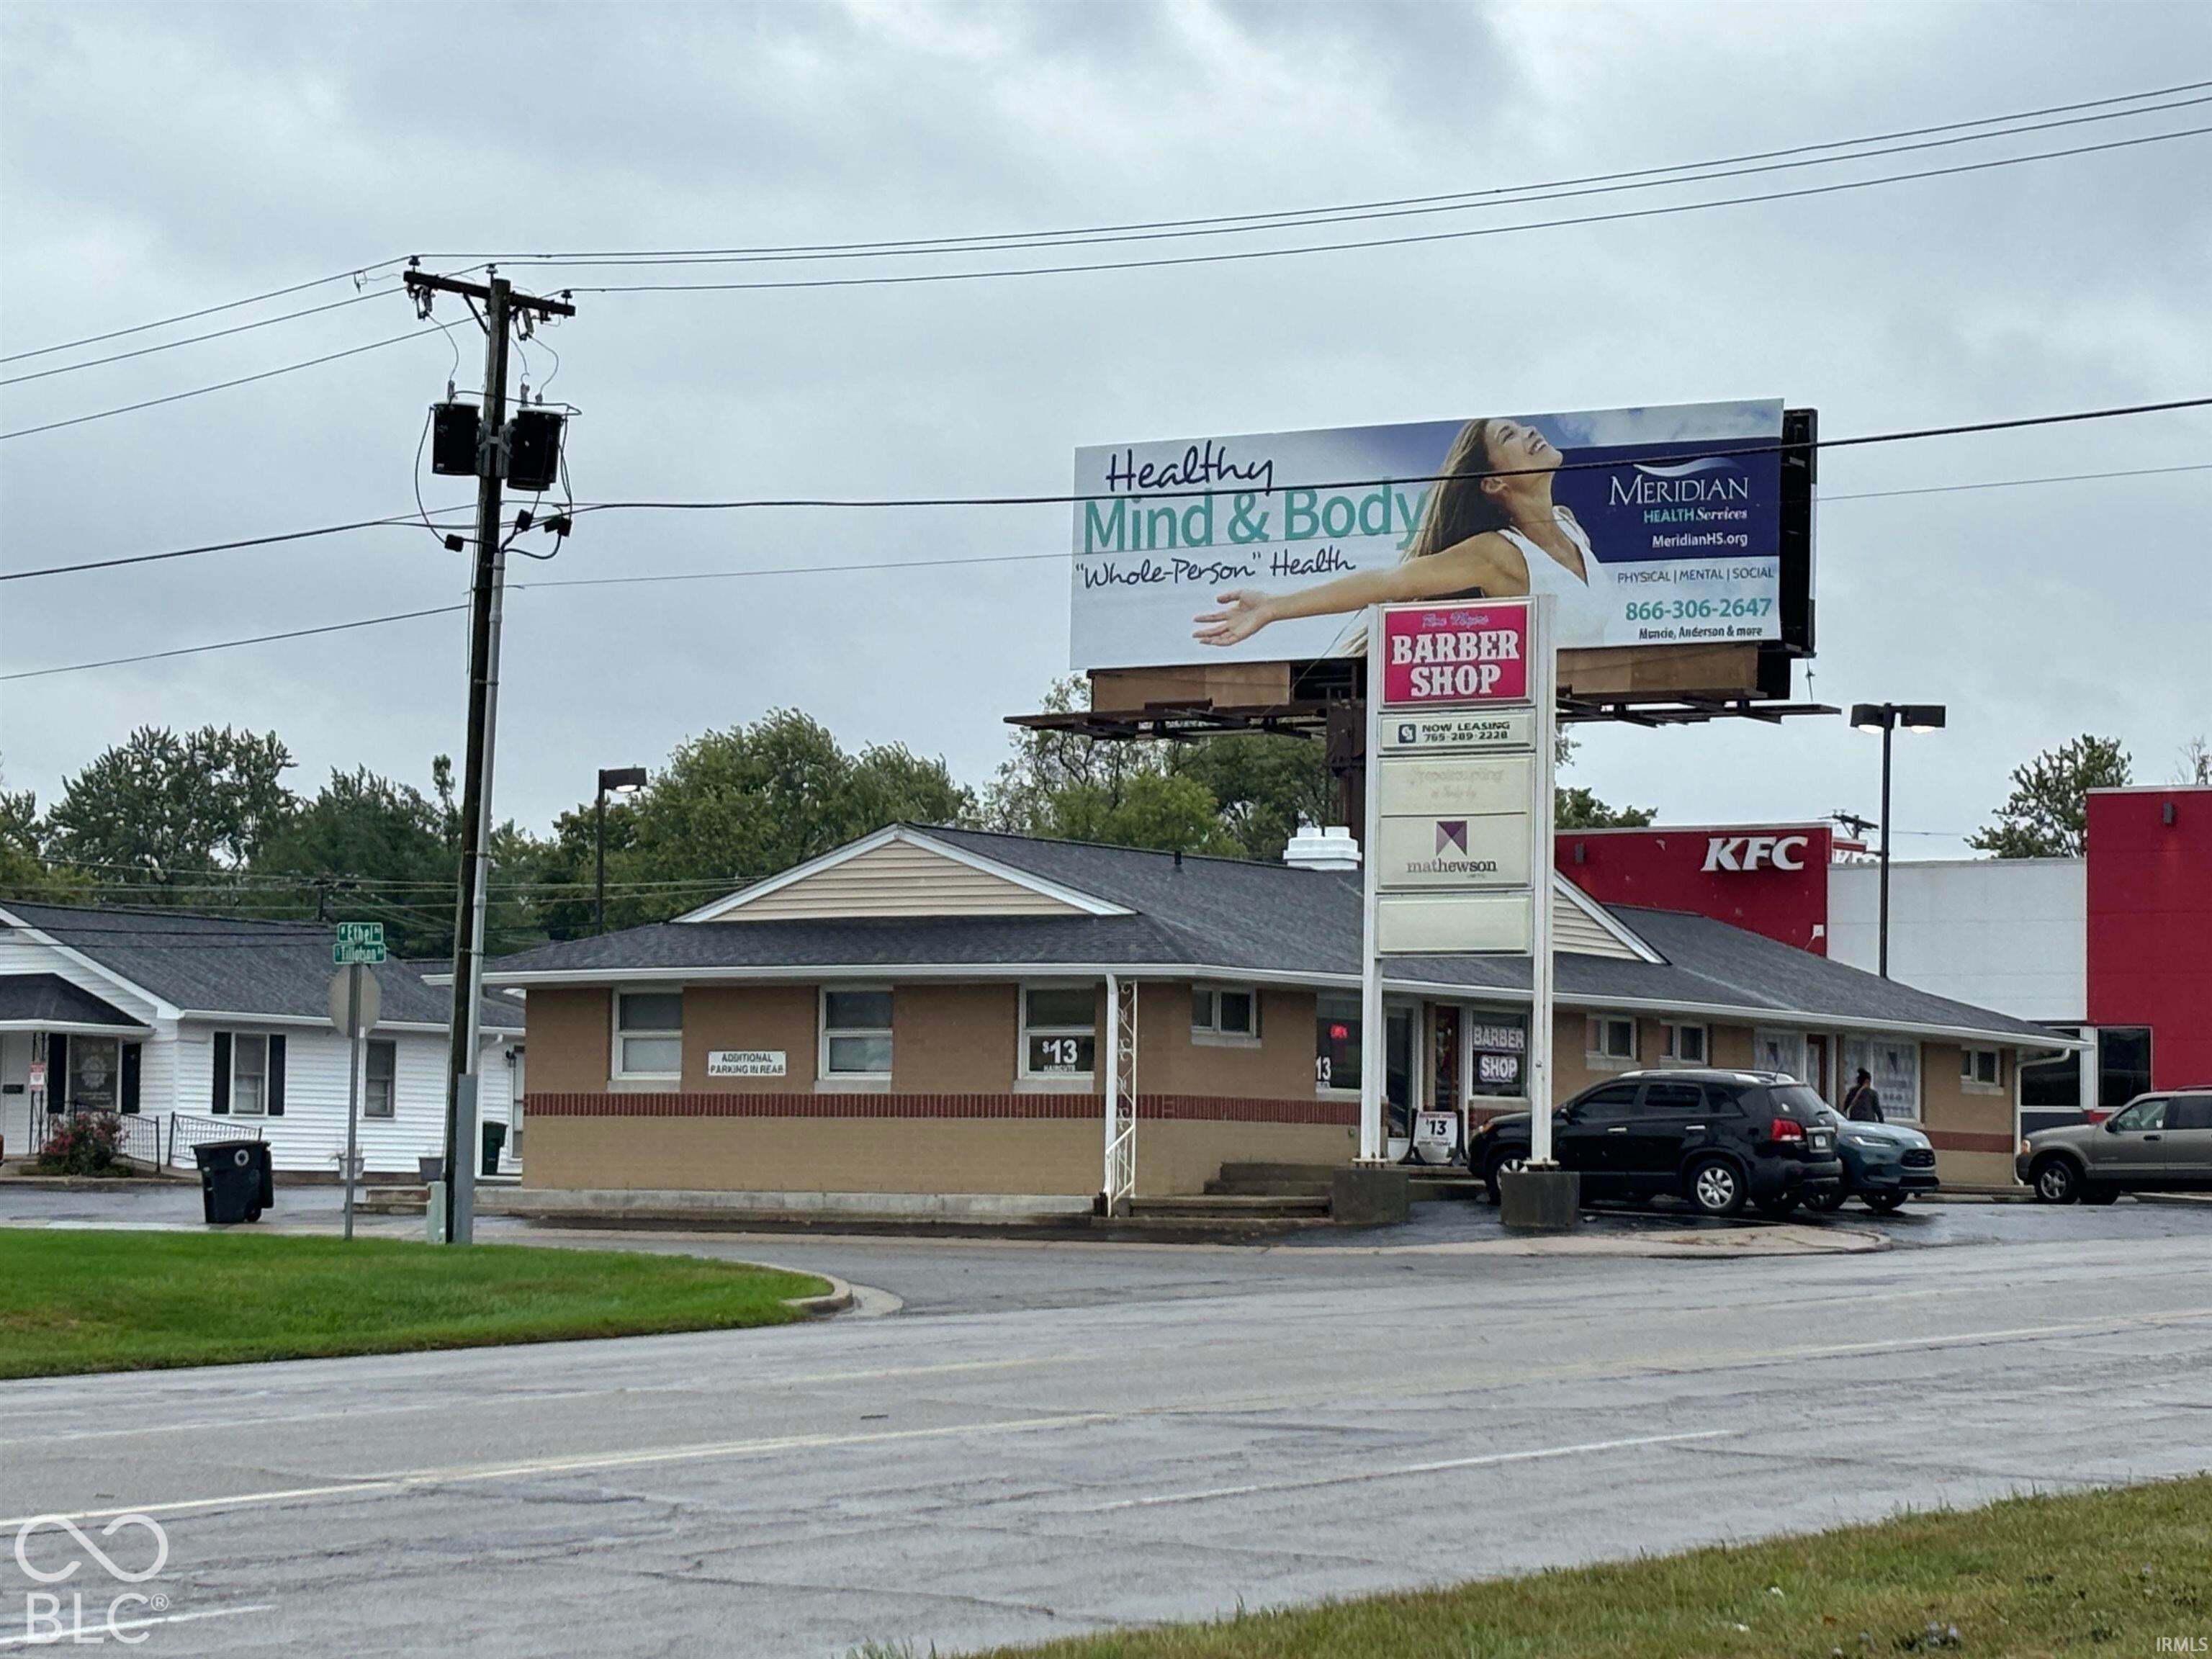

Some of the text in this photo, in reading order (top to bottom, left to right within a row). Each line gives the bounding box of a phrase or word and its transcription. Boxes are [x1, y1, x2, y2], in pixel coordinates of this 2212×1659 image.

[1106, 440, 1273, 496] Healthy
[1085, 477, 1426, 554] Mind & Body
[1643, 506, 1748, 523] HEALTH Services
[1653, 532, 1748, 549] MeridianHS.org
[1270, 545, 1357, 577] Health
[1617, 567, 1774, 584] PHYSICAL MENTAL SOCIAL
[1625, 598, 1773, 621] 866-306-2647
[1639, 624, 1763, 640] Muncie, Anderson & more
[1391, 629, 1520, 665] BARBER
[1410, 664, 1502, 698] SHOP
[1422, 721, 1511, 733] NOW LEASING
[1700, 836, 1808, 872] KFC
[1407, 858, 1498, 873] mathewson
[347, 924, 374, 942] Ethel
[341, 945, 377, 961] Tillotson
[1473, 1026, 1525, 1049] BARBER
[721, 1053, 773, 1063] ADDITIONAL
[1042, 1038, 1078, 1064] $13
[709, 1064, 784, 1074] PARKING IN REAR
[1480, 1054, 1519, 1079] SHOP
